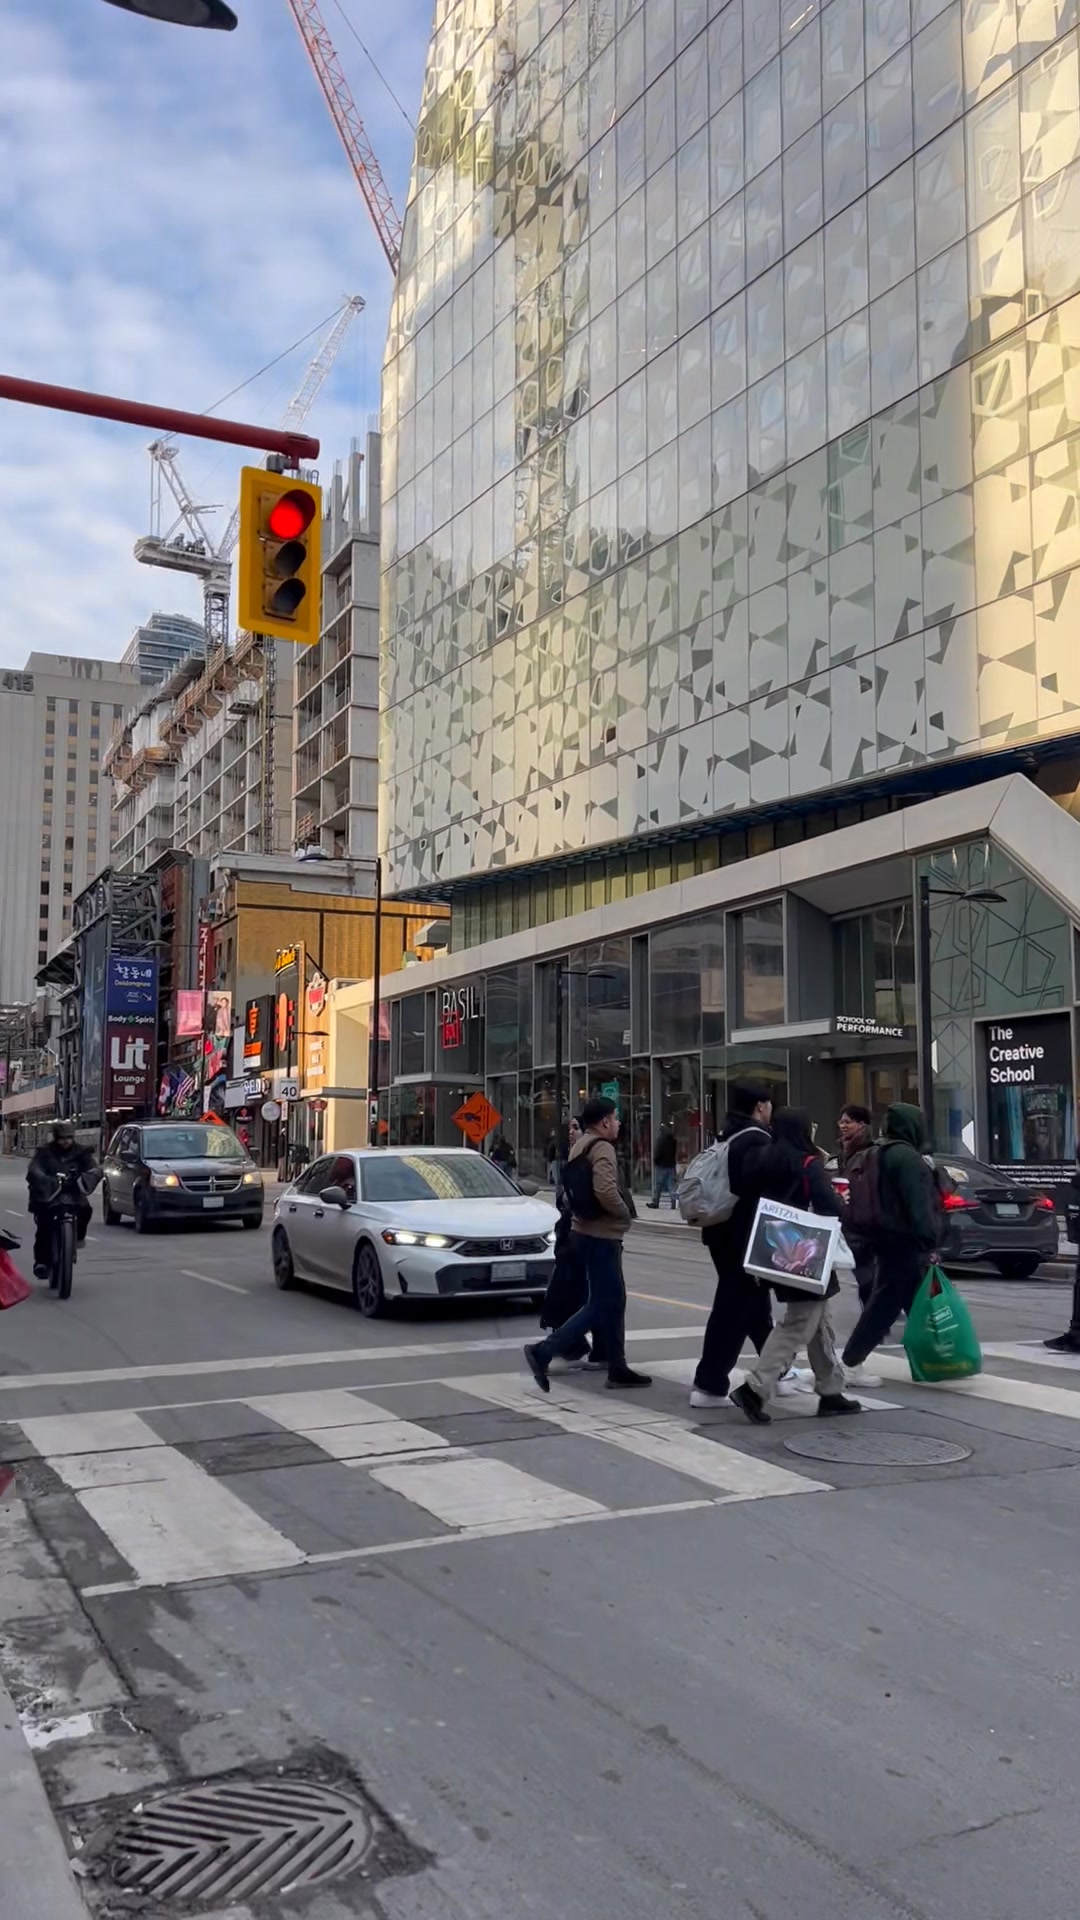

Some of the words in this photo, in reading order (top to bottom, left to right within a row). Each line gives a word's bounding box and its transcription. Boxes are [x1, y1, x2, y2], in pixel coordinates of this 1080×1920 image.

[2, 671, 34, 692] 415
[443, 986, 478, 1023] BASIL
[108, 1014, 127, 1024] Body
[135, 1015, 155, 1024] Spirit
[836, 1015, 865, 1025] SCHOOL
[836, 1023, 903, 1037] PERFORMANCE
[989, 1026, 1013, 1041] The
[989, 1044, 1044, 1062] Creative
[113, 1074, 146, 1084] Lounge
[990, 1065, 1035, 1083] School
[281, 1086, 297, 1097] 40
[761, 1203, 799, 1221] ARITZIA
